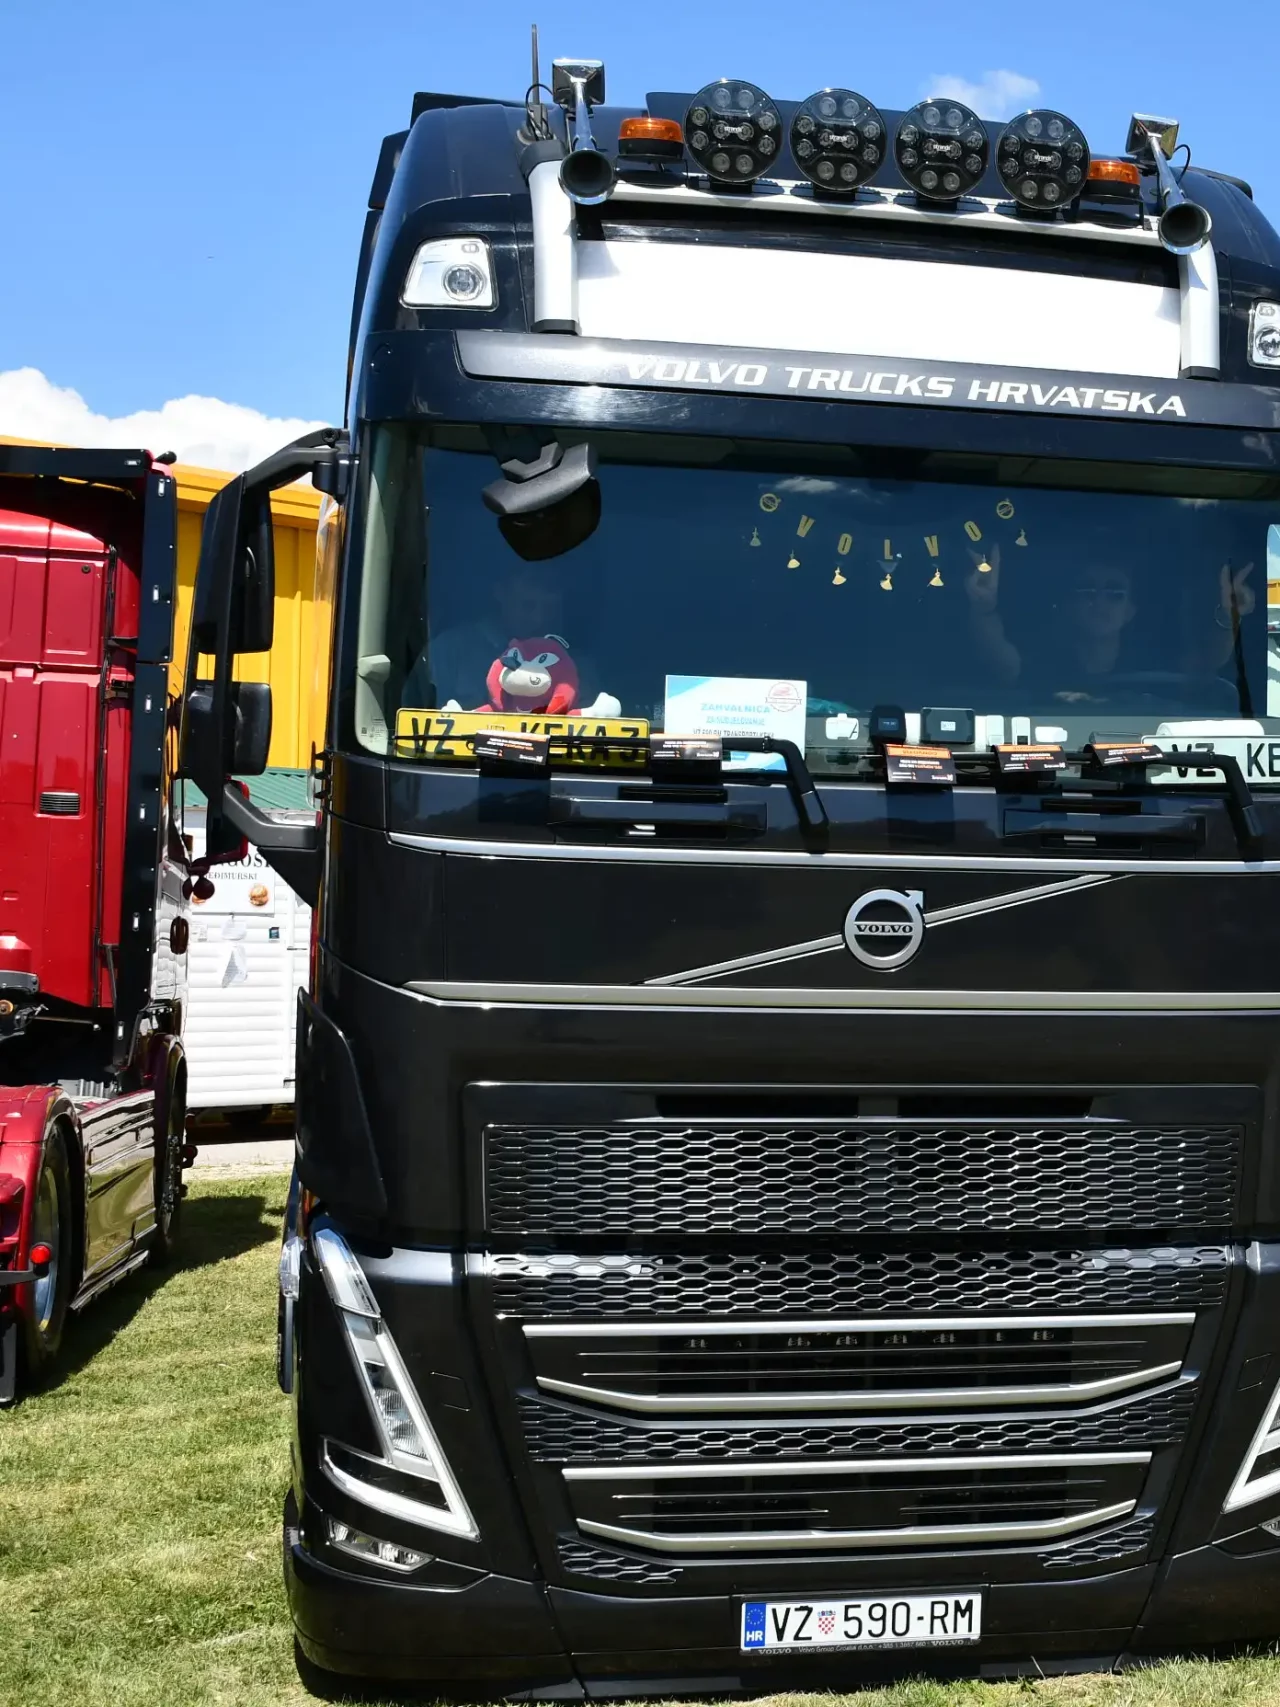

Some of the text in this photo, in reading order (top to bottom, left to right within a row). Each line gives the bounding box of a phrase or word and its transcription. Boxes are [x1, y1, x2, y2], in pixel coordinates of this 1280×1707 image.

[624, 358, 1189, 418] VOLVO TRUCKS HRVATSKA
[796, 501, 983, 560] VOLVO
[855, 924, 913, 934] VOLVO
[746, 1630, 764, 1643] HR
[843, 1598, 974, 1640] 590-RM
[758, 1647, 792, 1655] VOLVO
[931, 1639, 964, 1647] VOLVO
